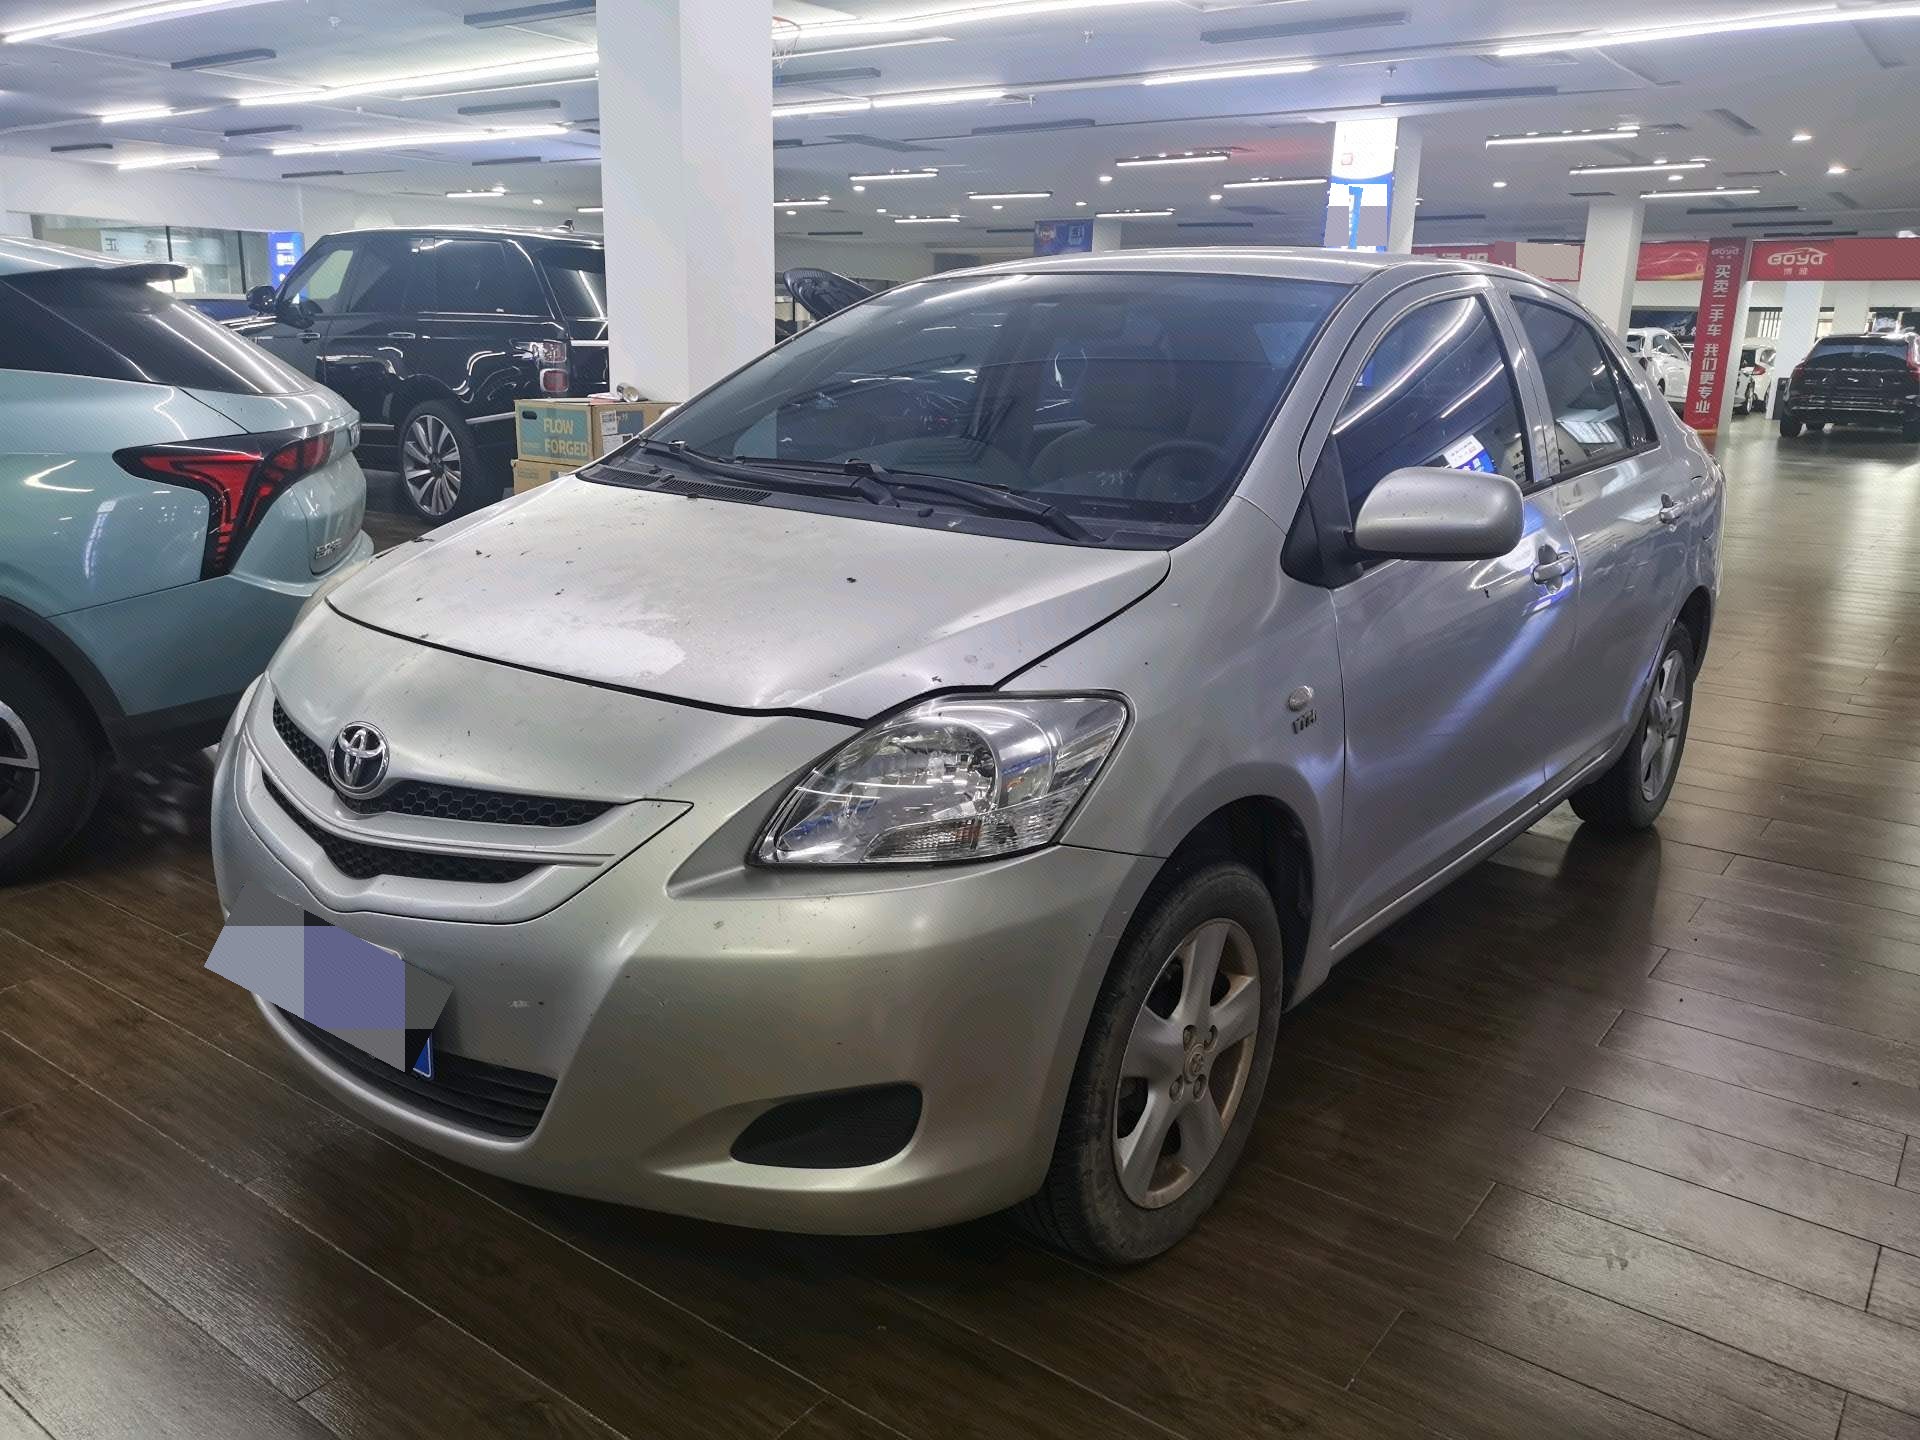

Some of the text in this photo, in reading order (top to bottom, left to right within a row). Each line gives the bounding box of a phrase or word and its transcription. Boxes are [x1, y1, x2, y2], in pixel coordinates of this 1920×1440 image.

[1706, 264, 1731, 336] 买卖二手车
[1695, 343, 1719, 413] 我们更专业
[543, 418, 574, 435] FLOW
[544, 439, 587, 455] FORGED
